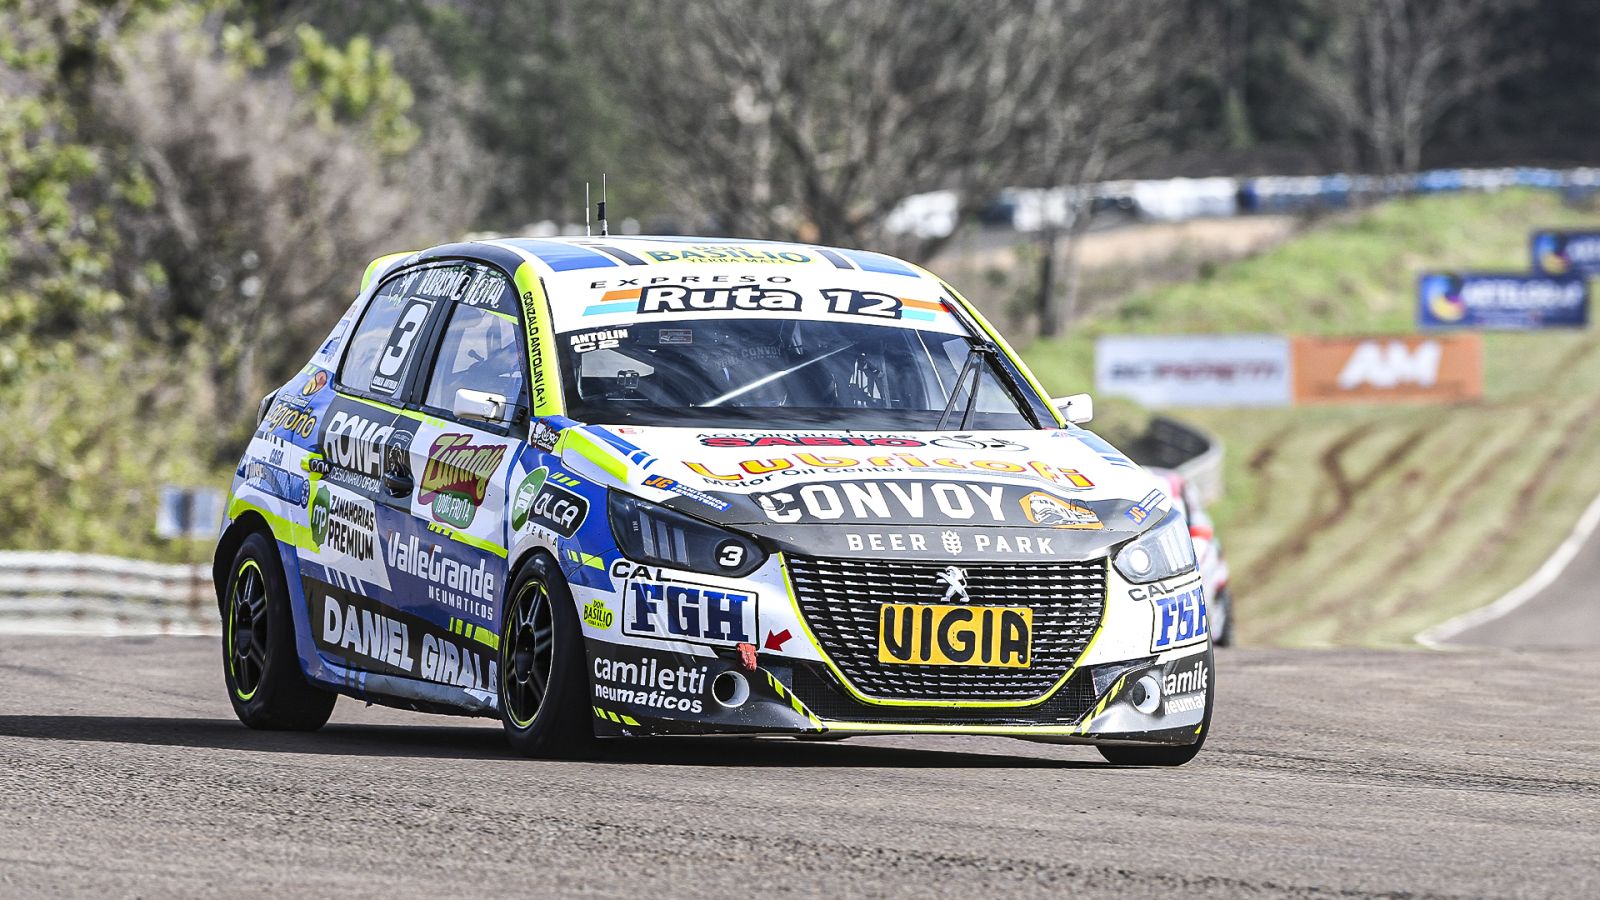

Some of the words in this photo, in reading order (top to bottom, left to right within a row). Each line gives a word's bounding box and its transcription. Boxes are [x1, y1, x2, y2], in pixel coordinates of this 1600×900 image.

[646, 249, 811, 264] BASILIO
[589, 275, 793, 290] EXPRESO
[523, 291, 539, 336] GONZALO
[637, 284, 803, 315] Ruta
[819, 288, 903, 319] 12
[379, 303, 430, 376] 3
[571, 328, 629, 346] ANTOLIN
[530, 337, 545, 384] ANTOLIN
[323, 411, 396, 480] ROMA
[699, 437, 927, 447] SABIO
[644, 476, 674, 489] JC
[702, 472, 773, 488] Motor
[781, 467, 815, 477] Oil
[823, 466, 907, 474] Center
[329, 495, 375, 532] ZANAHORIAS
[759, 482, 1006, 523] CONVOY
[327, 523, 374, 561] PREMIUM
[719, 546, 744, 567] 3
[845, 533, 928, 552] BEER
[974, 535, 1056, 555] PARK
[387, 531, 494, 602] ValleGrande
[612, 562, 672, 582] CAL
[428, 584, 494, 621] NEUMATICOS
[1128, 581, 1175, 601] CAL
[583, 605, 613, 627] BASILIO
[630, 583, 749, 642] FGH
[323, 595, 414, 672] DANIEL
[594, 656, 708, 695] camiletti
[594, 683, 704, 713] neumaticos
